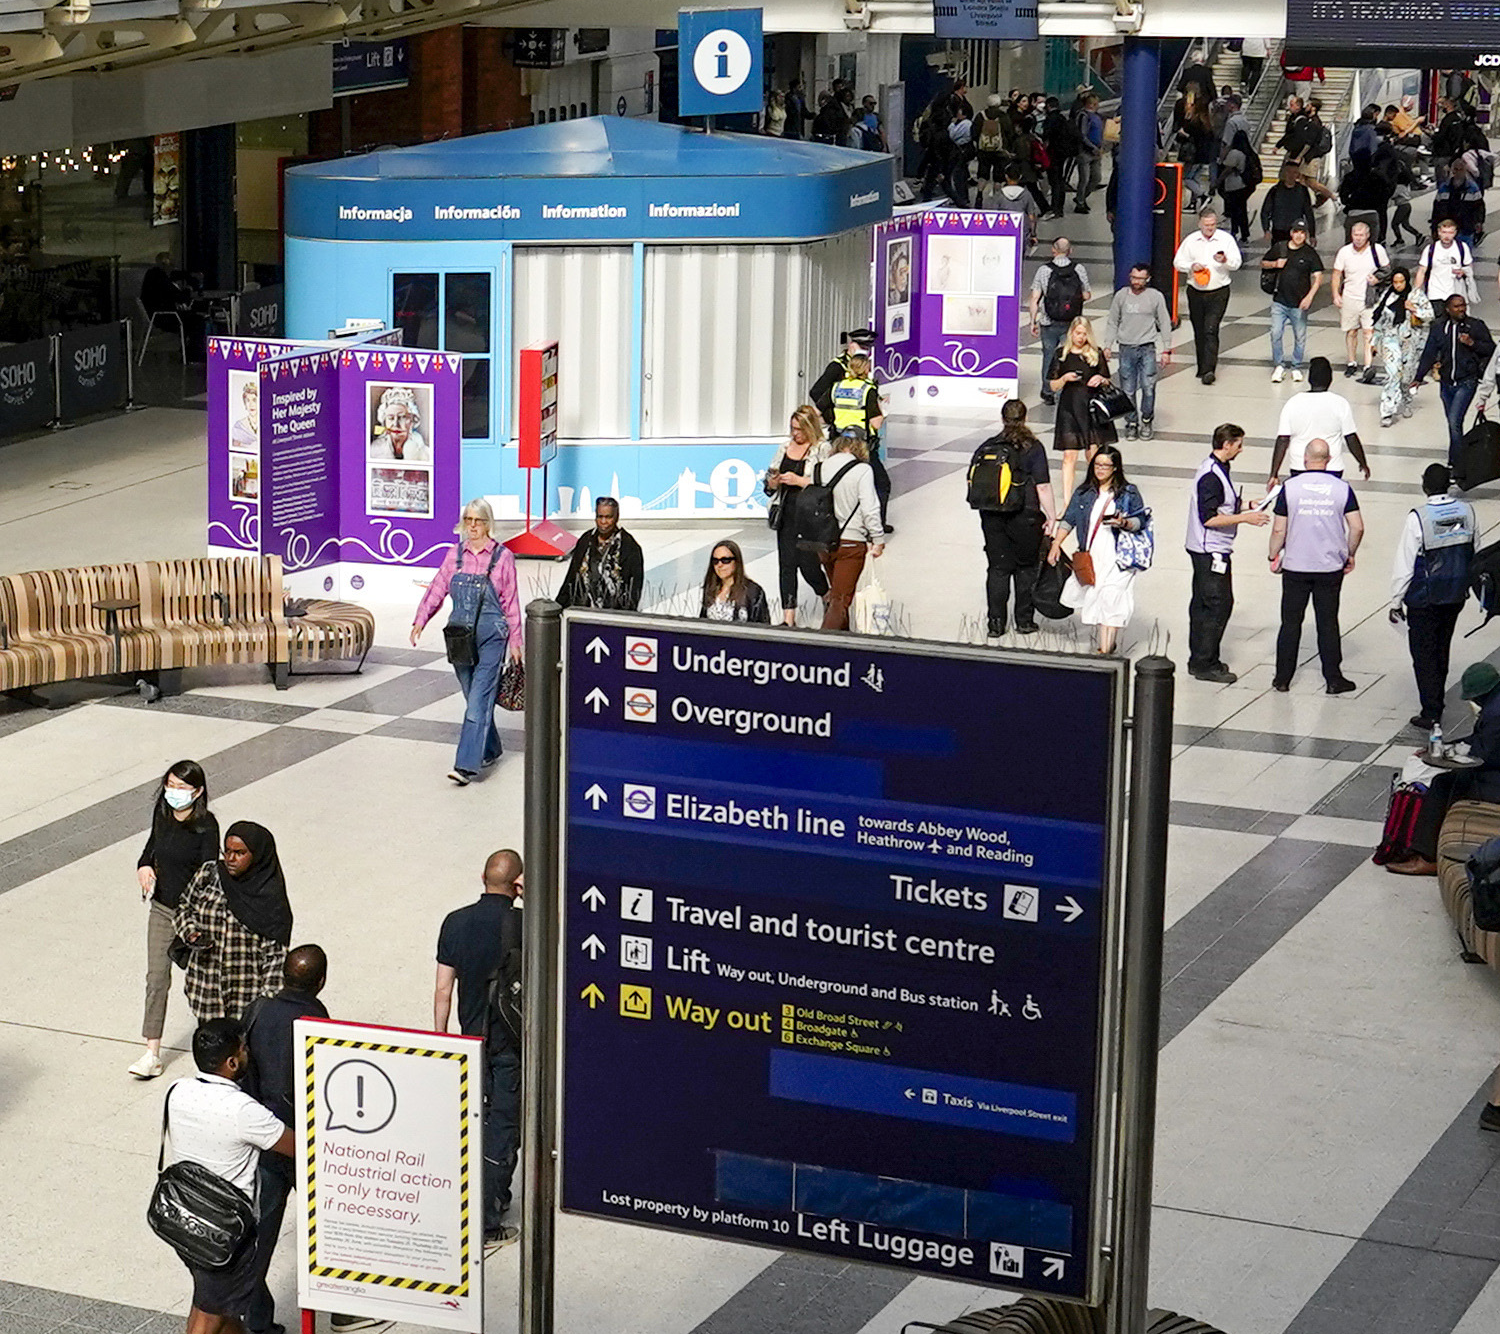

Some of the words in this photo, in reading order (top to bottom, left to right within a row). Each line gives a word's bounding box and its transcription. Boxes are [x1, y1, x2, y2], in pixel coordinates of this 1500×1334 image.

[1348, 2, 1443, 22] TRADING
[339, 206, 413, 224] Informacja
[434, 203, 520, 221] Información
[542, 204, 627, 219] Information
[648, 203, 740, 218] Informazioni
[250, 302, 278, 328] SOHO
[74, 344, 107, 371] SOHO
[0, 361, 36, 390] SOHO
[272, 388, 305, 406] Inspired
[306, 387, 317, 401] by
[272, 407, 287, 419] Her
[288, 402, 321, 418] Majesty
[272, 423, 288, 435] The
[289, 419, 316, 433] Queen
[671, 646, 852, 687] Underground
[671, 697, 832, 738] Overground
[667, 792, 789, 831] Elizabeth
[797, 808, 846, 838] line
[858, 816, 914, 834] towards
[917, 820, 963, 842] Abbey
[966, 826, 1011, 846] Wood,
[857, 832, 925, 853] Heathrow
[947, 841, 974, 857] and
[976, 845, 1035, 868] Reading
[890, 874, 988, 912] Tickets
[666, 896, 742, 930] Travel
[749, 911, 798, 939] and
[806, 917, 898, 953] tourist
[905, 934, 996, 965] centre
[667, 944, 711, 976] Lift
[717, 962, 746, 984] Way
[748, 968, 776, 986] out,
[778, 972, 868, 998] Underground
[871, 982, 897, 1001] and
[901, 987, 926, 1004] Bus
[929, 991, 979, 1013] station
[666, 994, 719, 1031] Way
[726, 1012, 773, 1033] out
[797, 1008, 814, 1019] Old
[816, 1012, 846, 1025] Broad
[848, 1015, 880, 1029] Street
[796, 1021, 847, 1039] Broadgate
[796, 1034, 844, 1051] Exchange
[845, 1041, 880, 1056] Square
[943, 1092, 974, 1109] Taxis
[990, 1103, 1027, 1118] Liverpool
[1027, 1109, 1052, 1121] Street
[322, 1141, 393, 1164] National
[395, 1151, 426, 1168] Rail
[323, 1160, 397, 1182] Industrial
[400, 1172, 452, 1190] action
[337, 1181, 372, 1201] only
[375, 1186, 420, 1204] travel
[323, 1195, 333, 1210] if
[337, 1200, 422, 1226] necessary.
[602, 1190, 631, 1207] Lost
[634, 1194, 690, 1219] property
[693, 1205, 710, 1222] by
[712, 1208, 770, 1233] platform
[772, 1219, 790, 1234] 10
[797, 1213, 851, 1245] Left
[858, 1223, 975, 1266] Luggage
